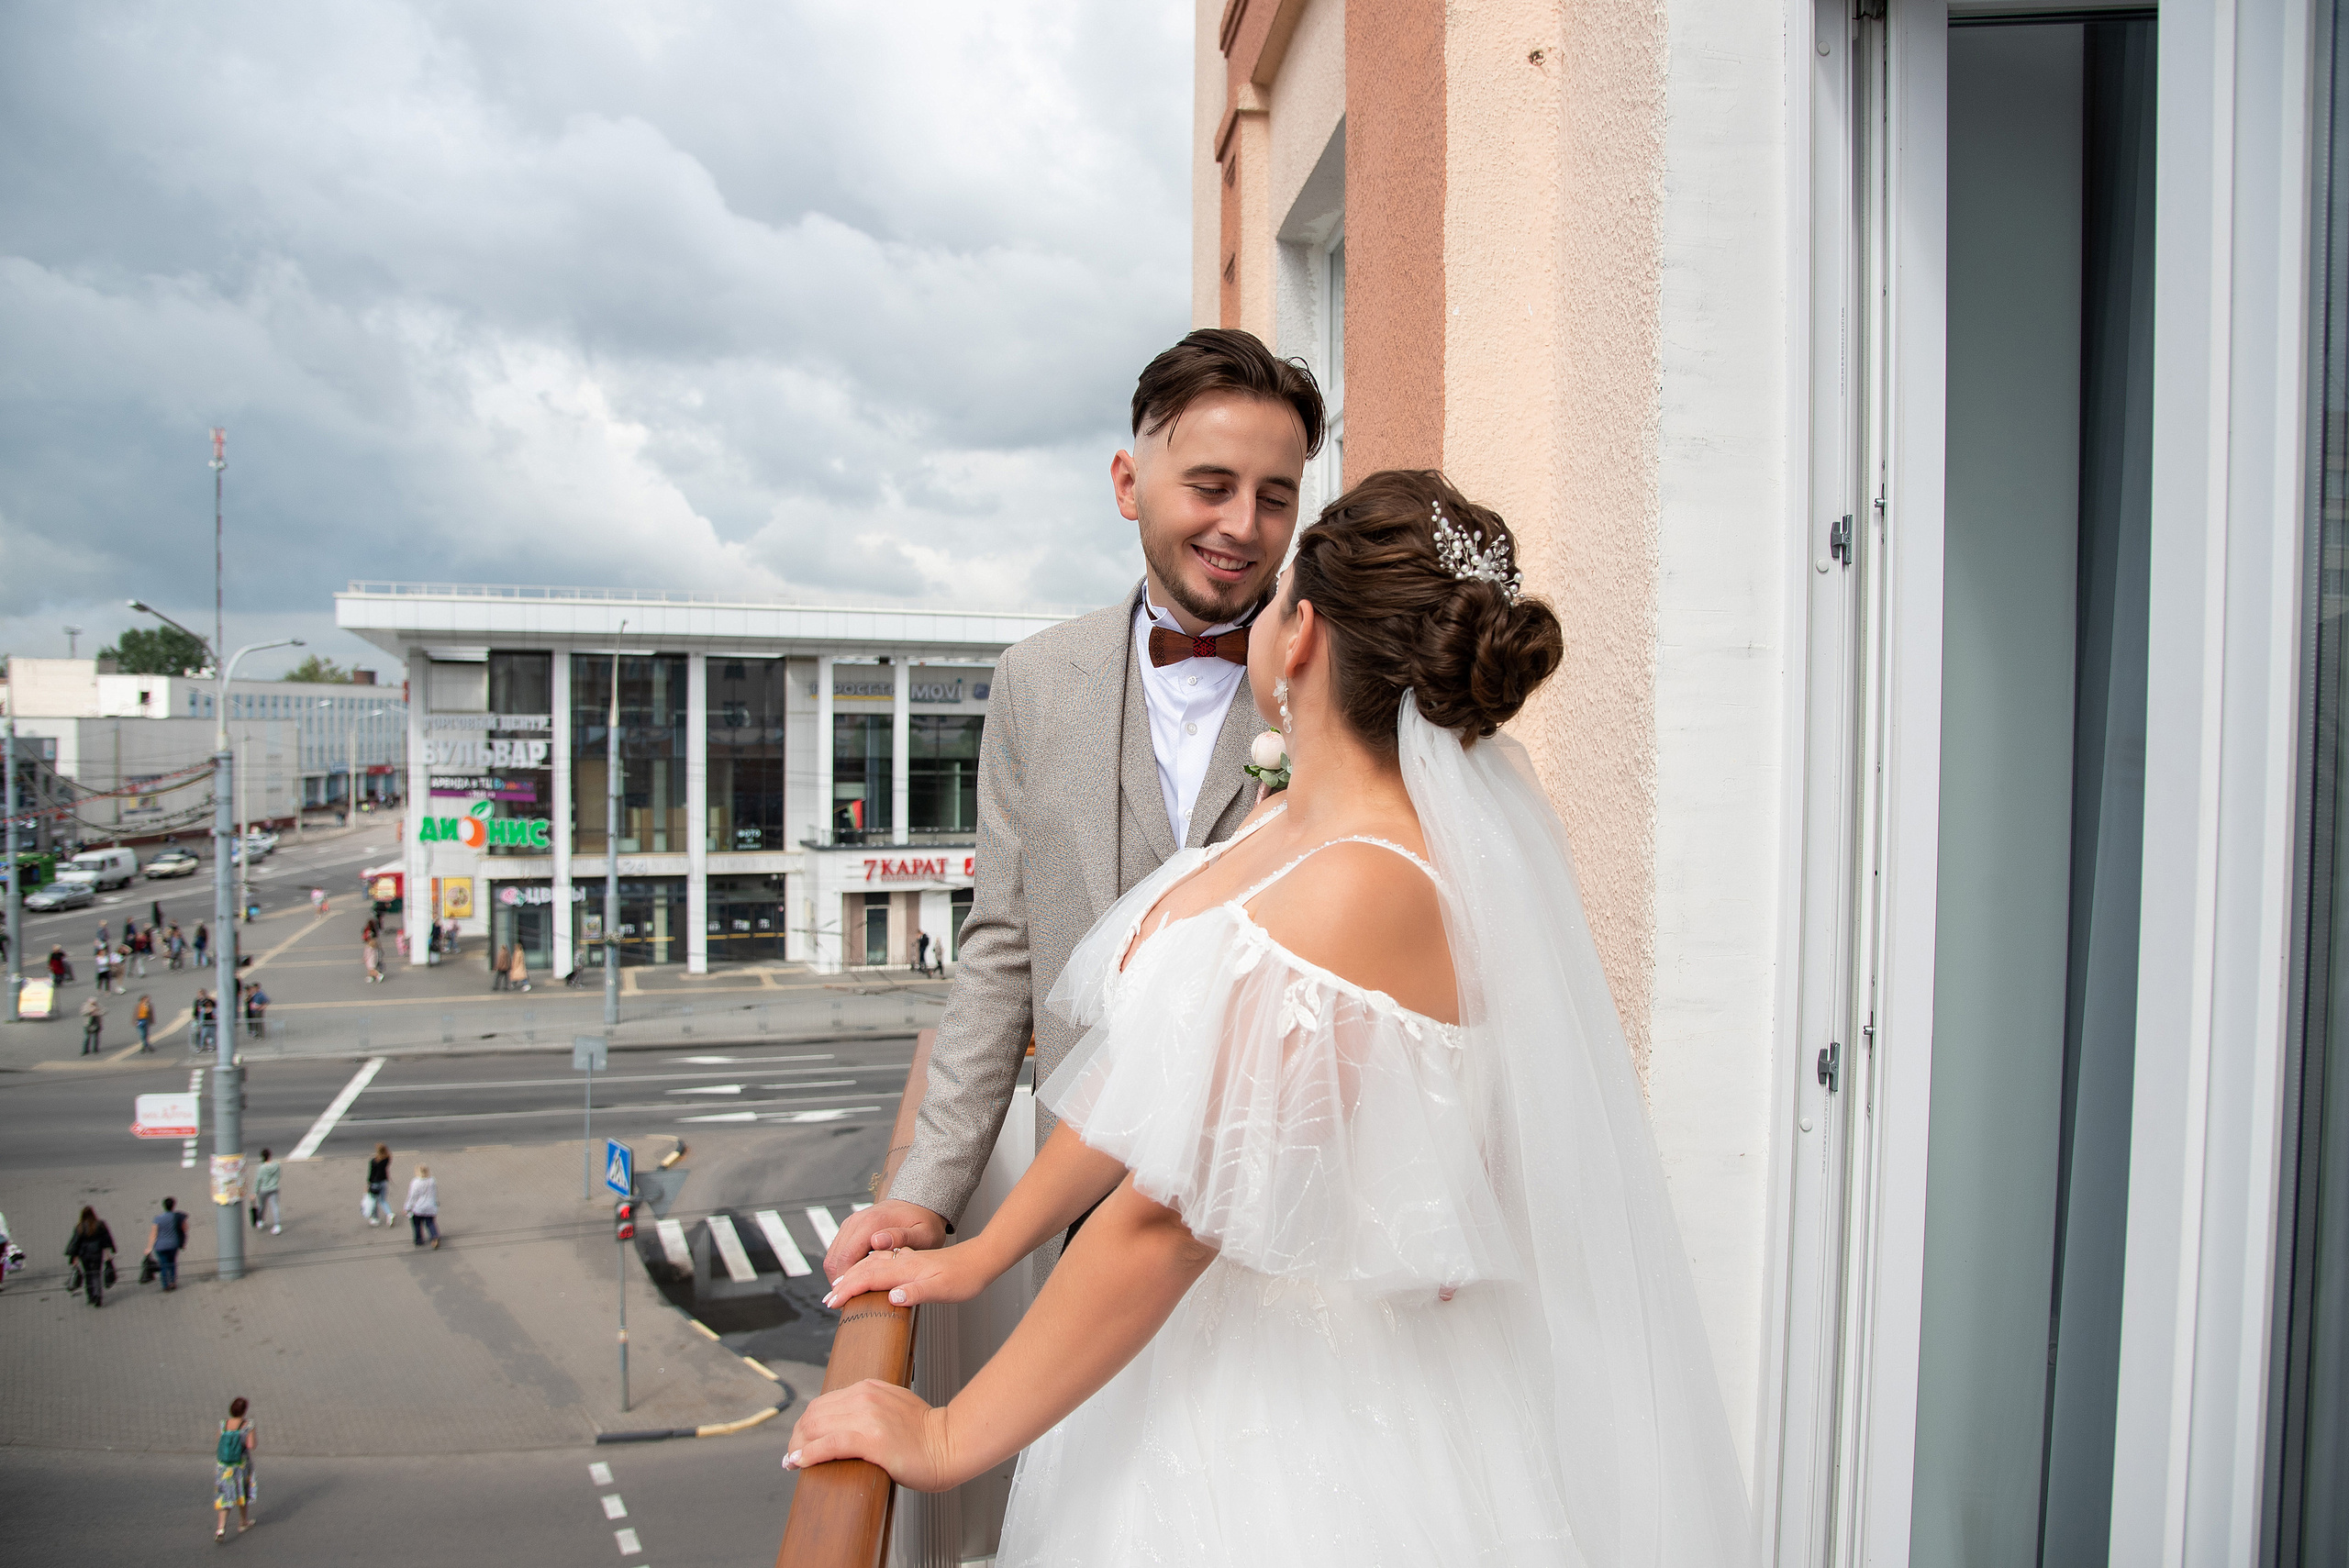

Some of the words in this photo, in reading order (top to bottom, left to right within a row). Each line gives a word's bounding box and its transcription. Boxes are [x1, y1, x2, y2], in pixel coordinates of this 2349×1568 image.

[500, 714, 550, 732] ЦЕНТР
[424, 739, 549, 769] БУЛЬВАР
[430, 776, 469, 790] АРЕНДА
[863, 859, 877, 882] 7
[880, 858, 949, 876] КАРАТ
[525, 886, 586, 906] ЦВЫ
